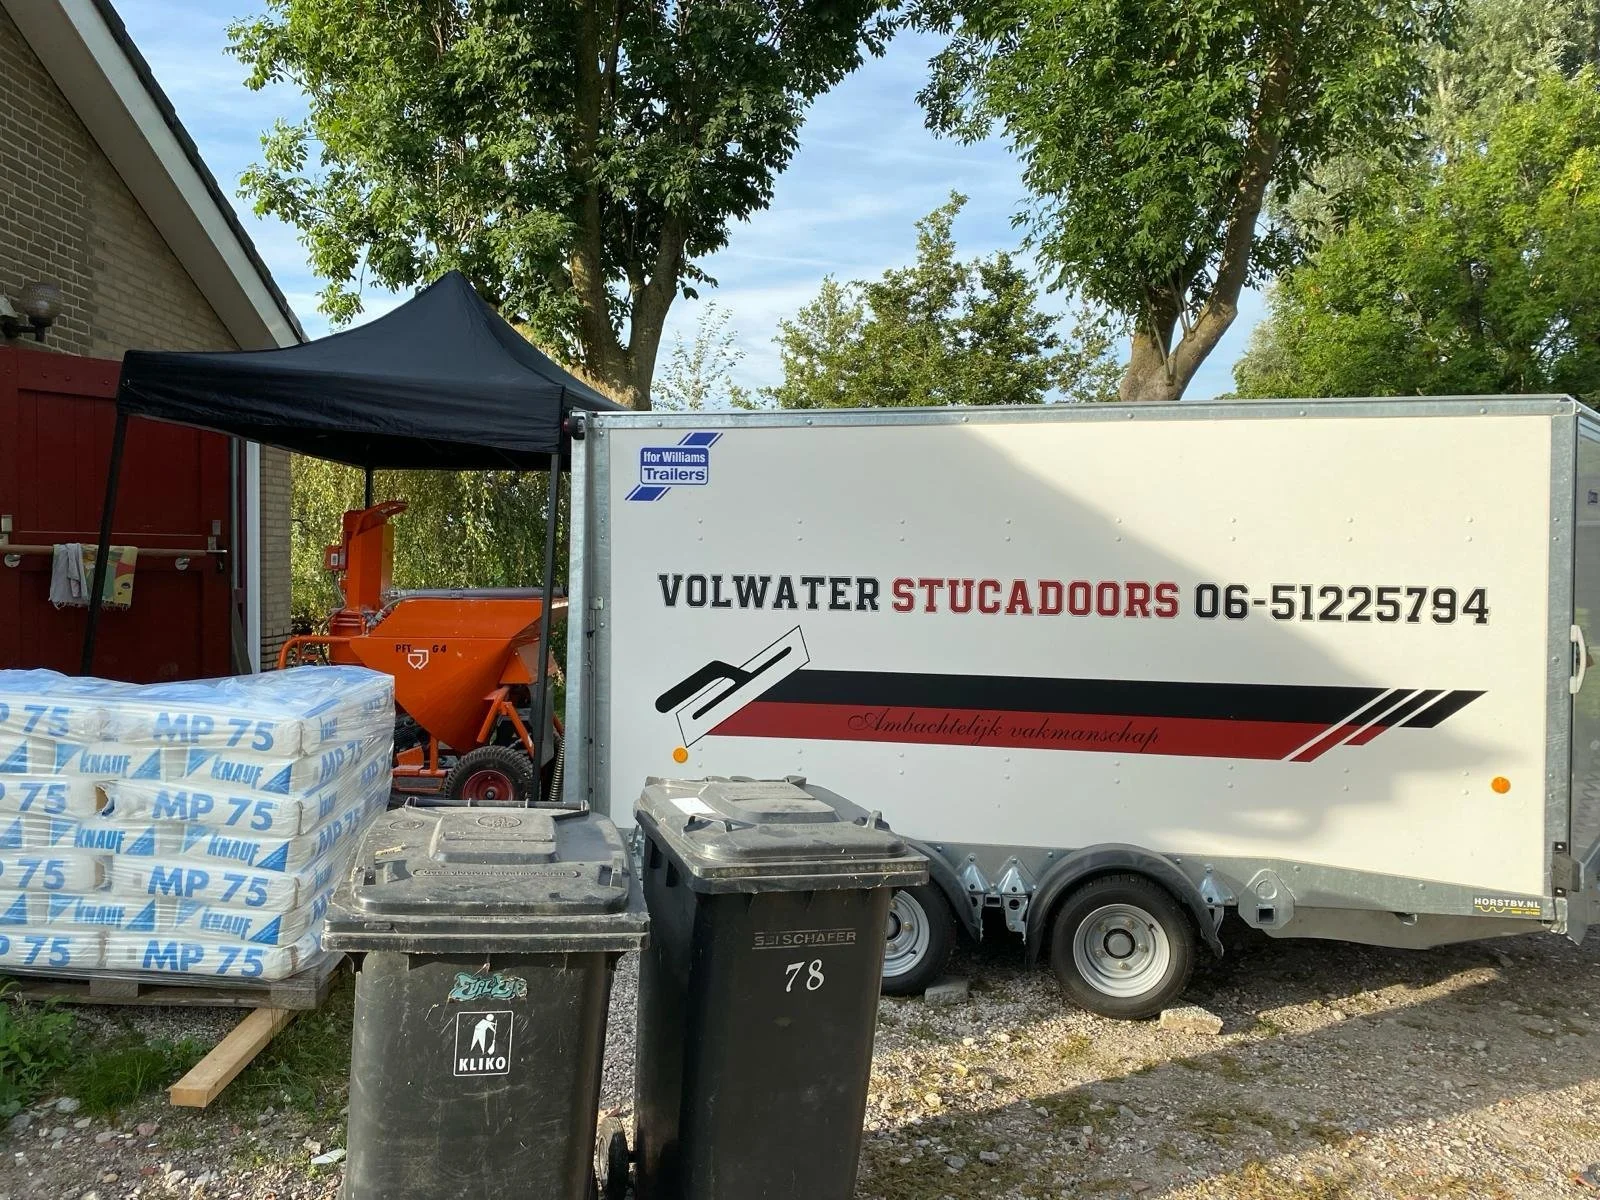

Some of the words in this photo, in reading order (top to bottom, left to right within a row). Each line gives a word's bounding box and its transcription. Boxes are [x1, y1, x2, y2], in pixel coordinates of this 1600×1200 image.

[643, 451, 660, 462] Ifor
[662, 451, 706, 463] Williams
[643, 467, 706, 481] Trailers
[656, 573, 881, 612] VOLWATER
[891, 577, 1180, 619] STUCADOORS
[1194, 582, 1490, 625] 06-51225794
[395, 644, 411, 653] PFT
[23, 704, 70, 737] 75
[153, 712, 214, 744] MP
[226, 718, 275, 752] 75
[848, 708, 1002, 745] Ambachtelijk
[1008, 718, 1159, 752] vakmanschap
[80, 748, 131, 778] KNAUF
[211, 752, 263, 790] KNAUF
[19, 782, 67, 814] 75
[151, 790, 214, 821] MP
[225, 797, 274, 831] 75
[74, 822, 126, 854] KNAUF
[207, 833, 260, 867] KNAUF
[17, 859, 65, 890] 75
[147, 865, 210, 898] MP
[219, 872, 269, 907] 75
[74, 896, 126, 928] KNAUF
[200, 905, 253, 941] KNAUF
[24, 935, 71, 968] 75
[142, 939, 204, 972] MP
[216, 946, 264, 978] 75
[785, 958, 825, 993] 78
[458, 1056, 506, 1072] KLIKO
